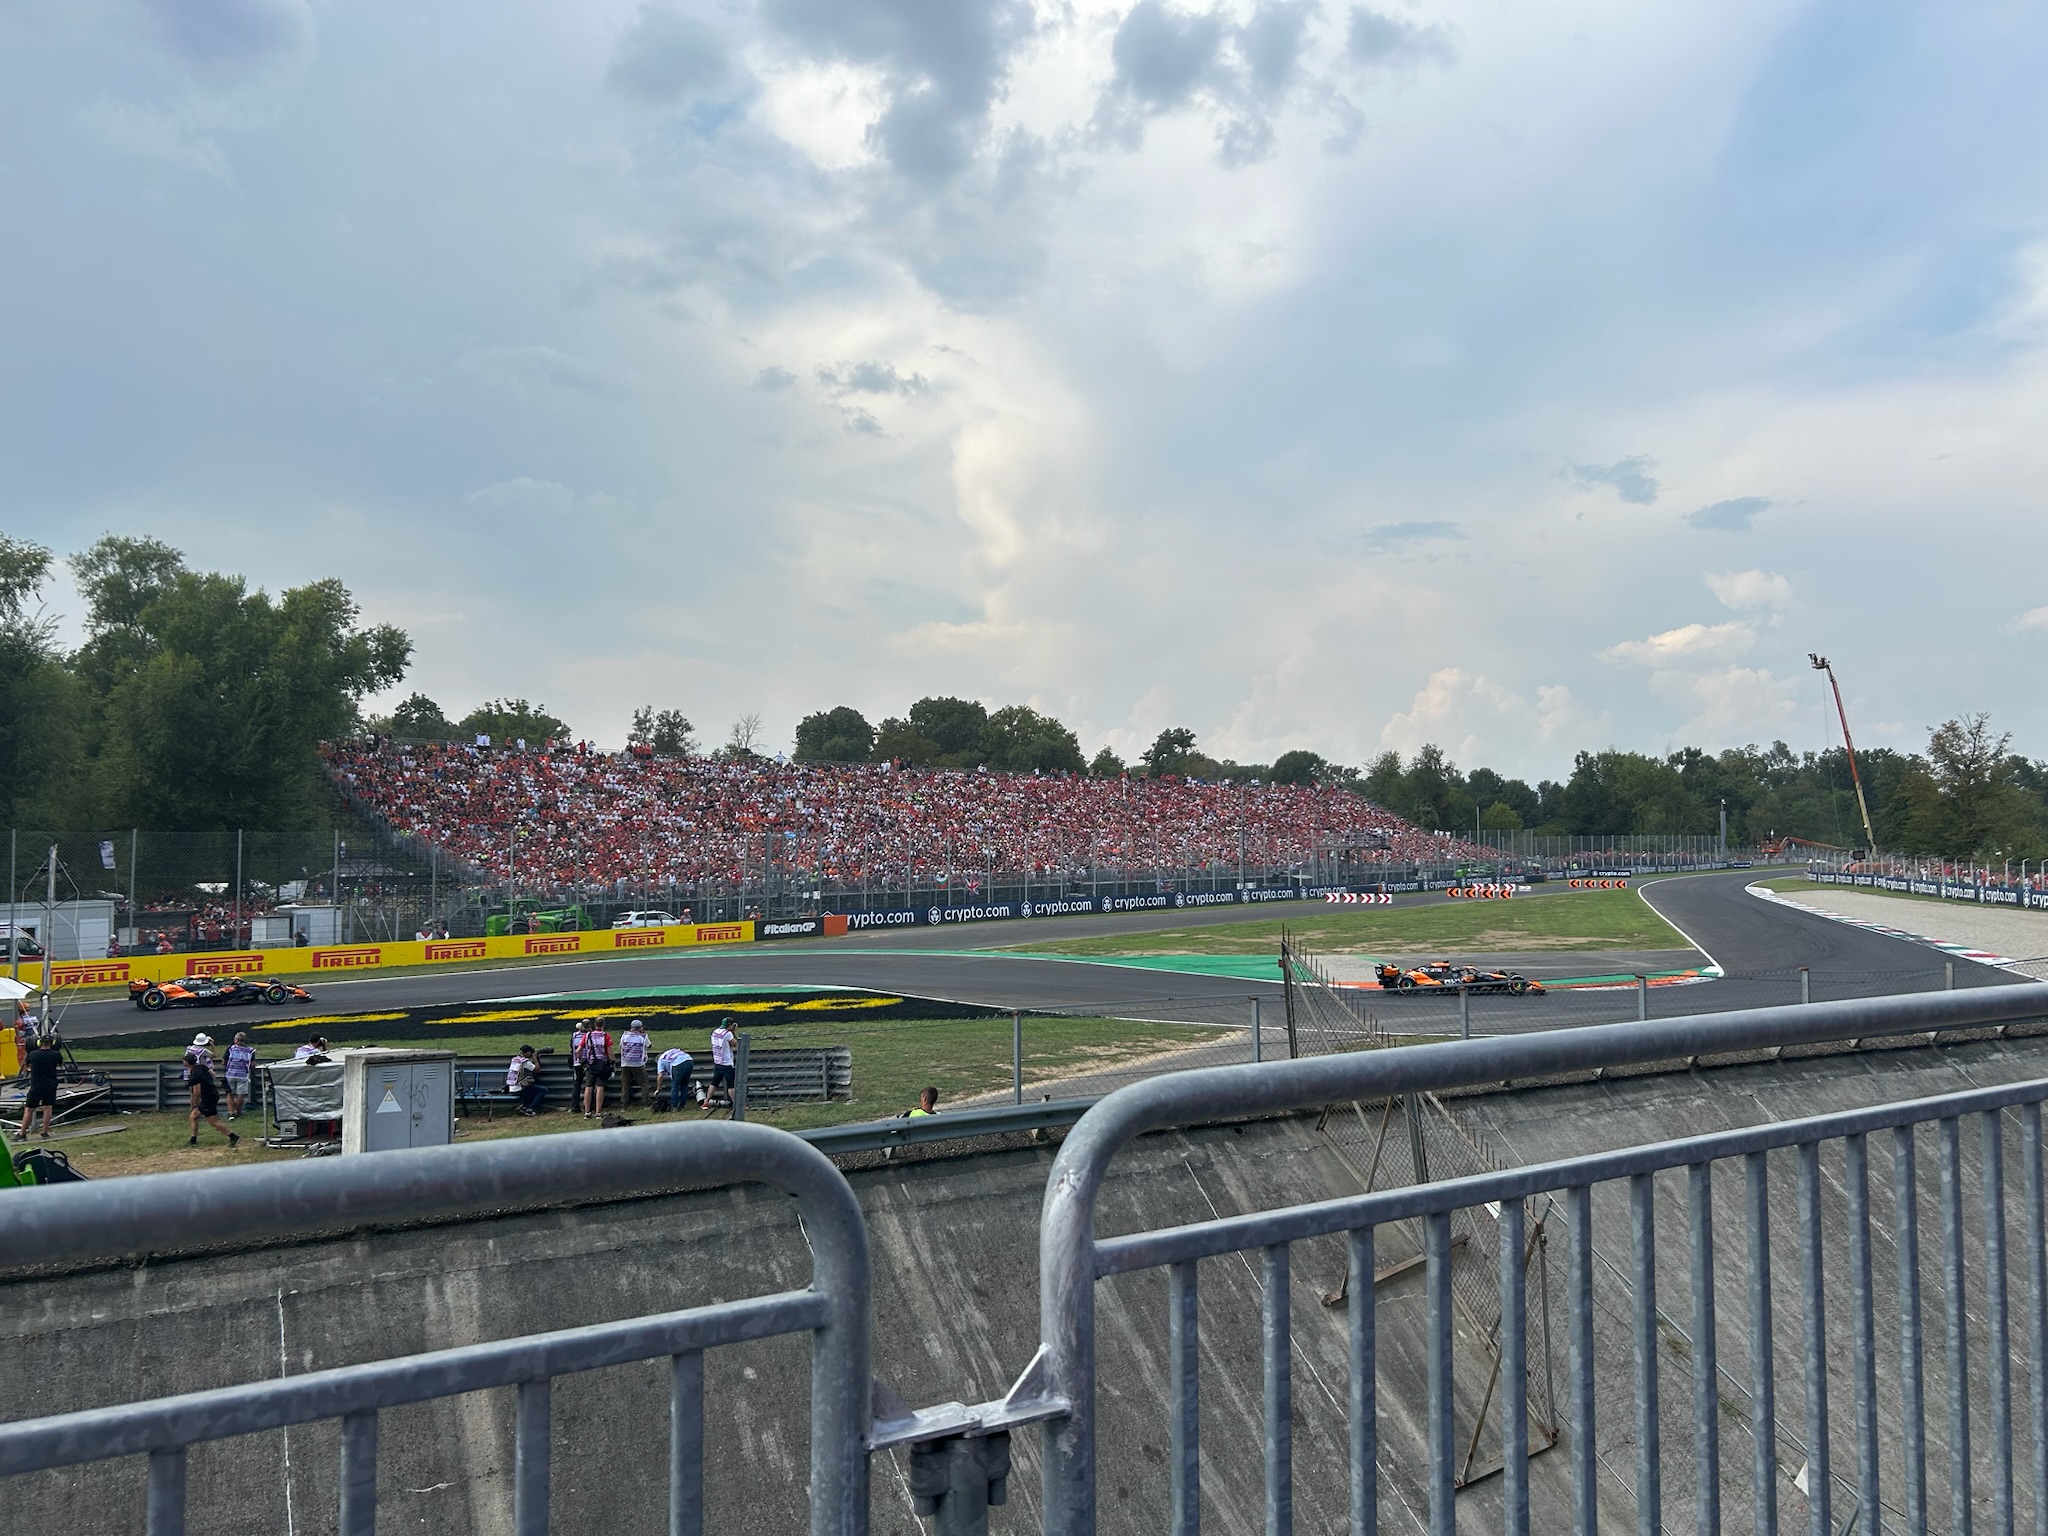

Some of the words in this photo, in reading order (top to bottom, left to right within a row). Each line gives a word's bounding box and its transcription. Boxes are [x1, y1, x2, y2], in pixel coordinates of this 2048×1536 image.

[1251, 888, 1294, 901] crypto.com
[1309, 885, 1347, 897] cryptocom
[1387, 881, 1418, 893] crypto.com
[1915, 881, 1937, 894] crypto.com
[1947, 885, 1975, 899] crypto.com
[1114, 895, 1167, 910] crypto.com
[1186, 892, 1233, 906] crypto.com
[1986, 888, 2017, 903] crypto.com
[944, 905, 1010, 922] crypto.com
[1035, 899, 1092, 916] crypto.com
[847, 910, 915, 928] rypto.com
[615, 931, 665, 947] PIRELLI
[697, 926, 741, 941] PIRELLI
[425, 942, 486, 960] PIRELLI
[525, 936, 580, 954] PIRELLI
[186, 955, 264, 975] PIRELLI
[312, 948, 381, 968] PIRELLI
